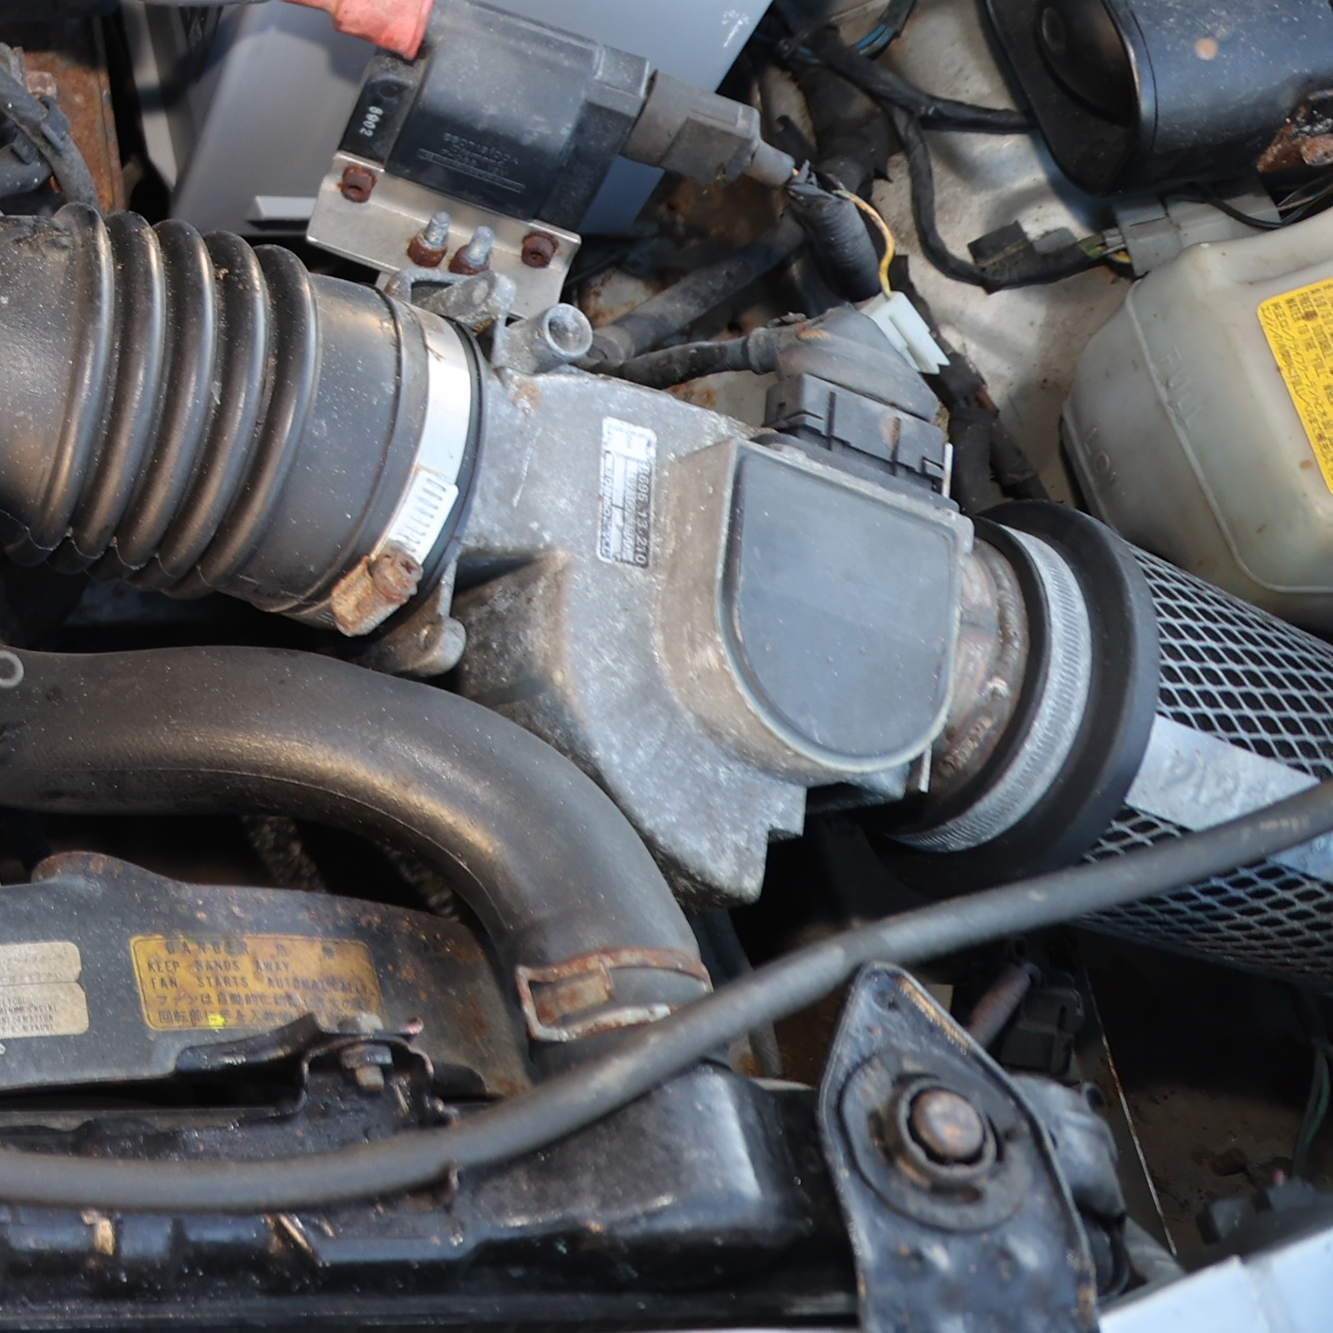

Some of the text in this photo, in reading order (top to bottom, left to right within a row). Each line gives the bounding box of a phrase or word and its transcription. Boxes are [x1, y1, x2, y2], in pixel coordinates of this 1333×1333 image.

[147, 961, 181, 974] KEEP
[255, 960, 290, 973] AWAY
[151, 977, 179, 990] FAN
[197, 976, 250, 989] STARTS
